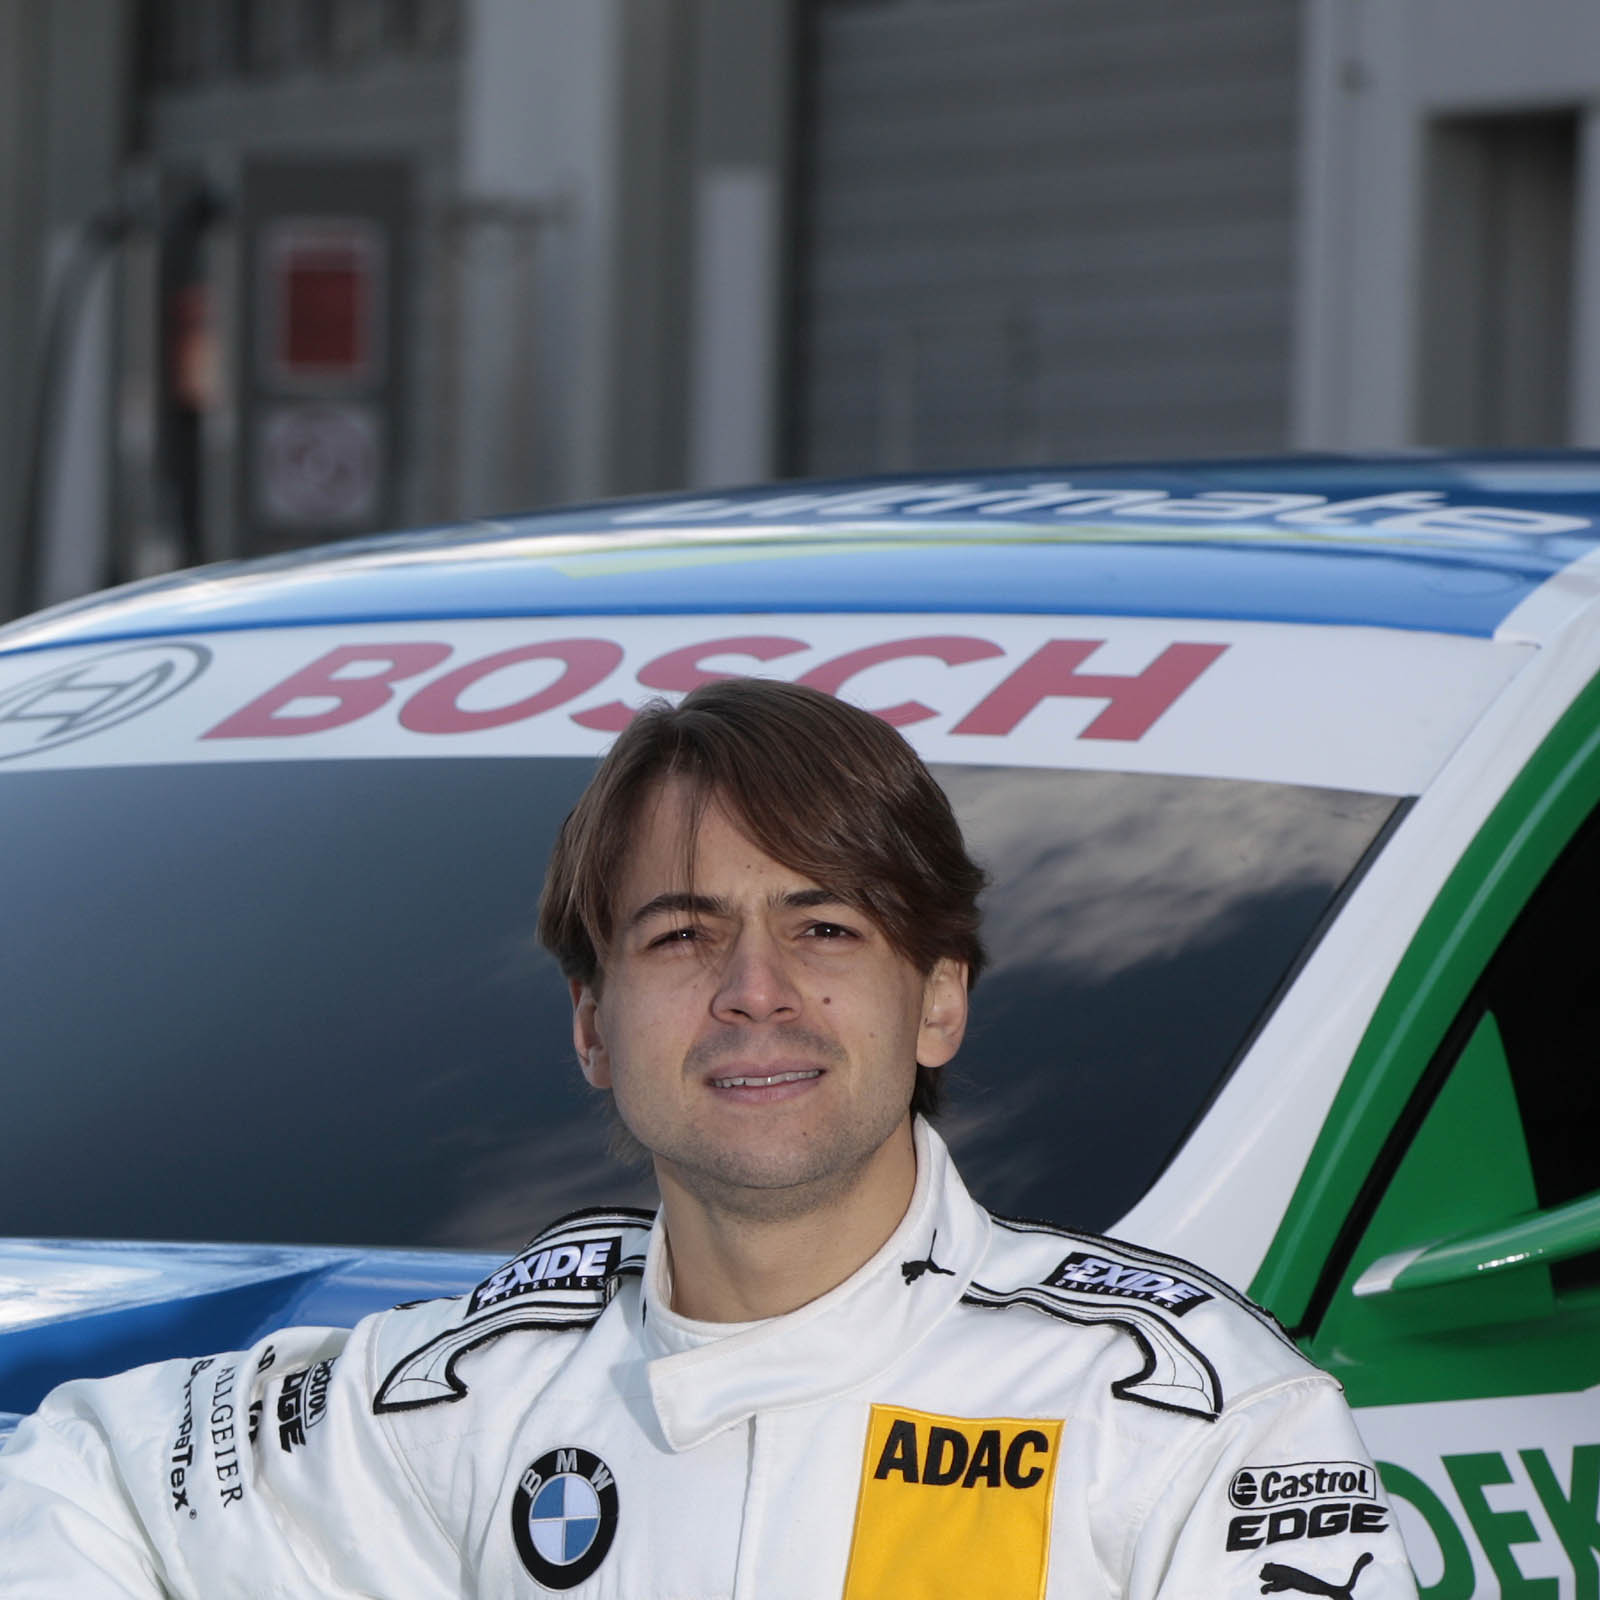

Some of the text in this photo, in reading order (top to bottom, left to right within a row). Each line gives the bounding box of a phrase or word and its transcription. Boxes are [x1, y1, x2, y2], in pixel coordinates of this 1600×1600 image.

[611, 482, 1593, 541] ultimate
[196, 636, 1233, 742] BOSCH
[477, 1242, 613, 1299] EXIDE
[1055, 1279, 1173, 1309] BATTERIES
[1064, 1258, 1205, 1304] EXIDE
[277, 1367, 311, 1453] DGE
[874, 1420, 1050, 1490] ADAC
[1259, 1467, 1369, 1503] Castrol
[1226, 1503, 1389, 1552] EDGE
